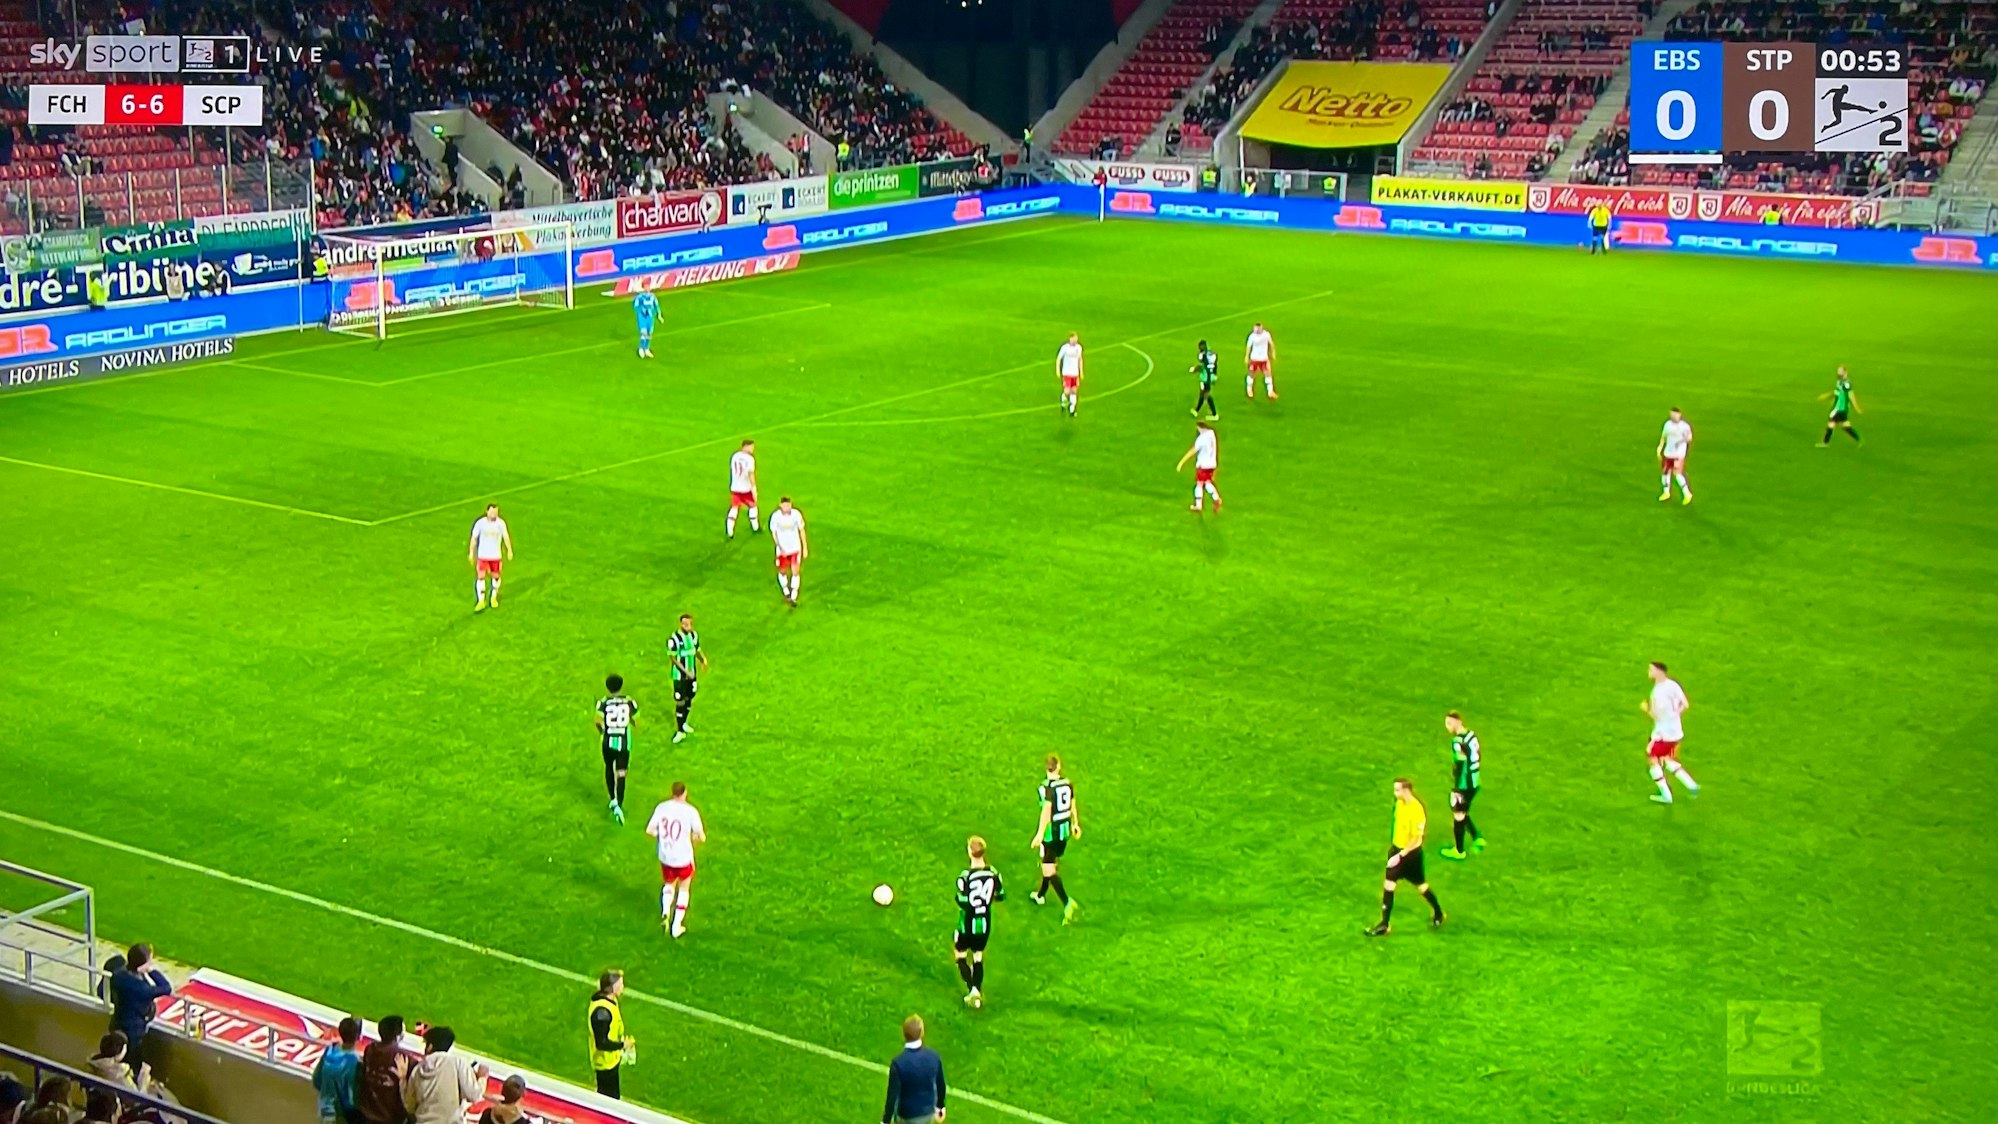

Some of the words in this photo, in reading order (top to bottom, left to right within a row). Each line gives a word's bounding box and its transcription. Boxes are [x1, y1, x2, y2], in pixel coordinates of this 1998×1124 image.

[1279, 85, 1413, 118] Netto
[1378, 187, 1521, 205] PLAKAT-VERKAUFT.DE
[1554, 187, 1579, 209] Mia
[1725, 195, 1752, 217] Mia
[673, 258, 748, 288] HEIZUNG
[9, 360, 80, 386] HOTELS
[101, 348, 166, 372] NOVINA
[171, 337, 234, 362] HOTELS
[605, 704, 631, 729] 28
[661, 817, 682, 840] 30
[969, 878, 995, 908] 24
